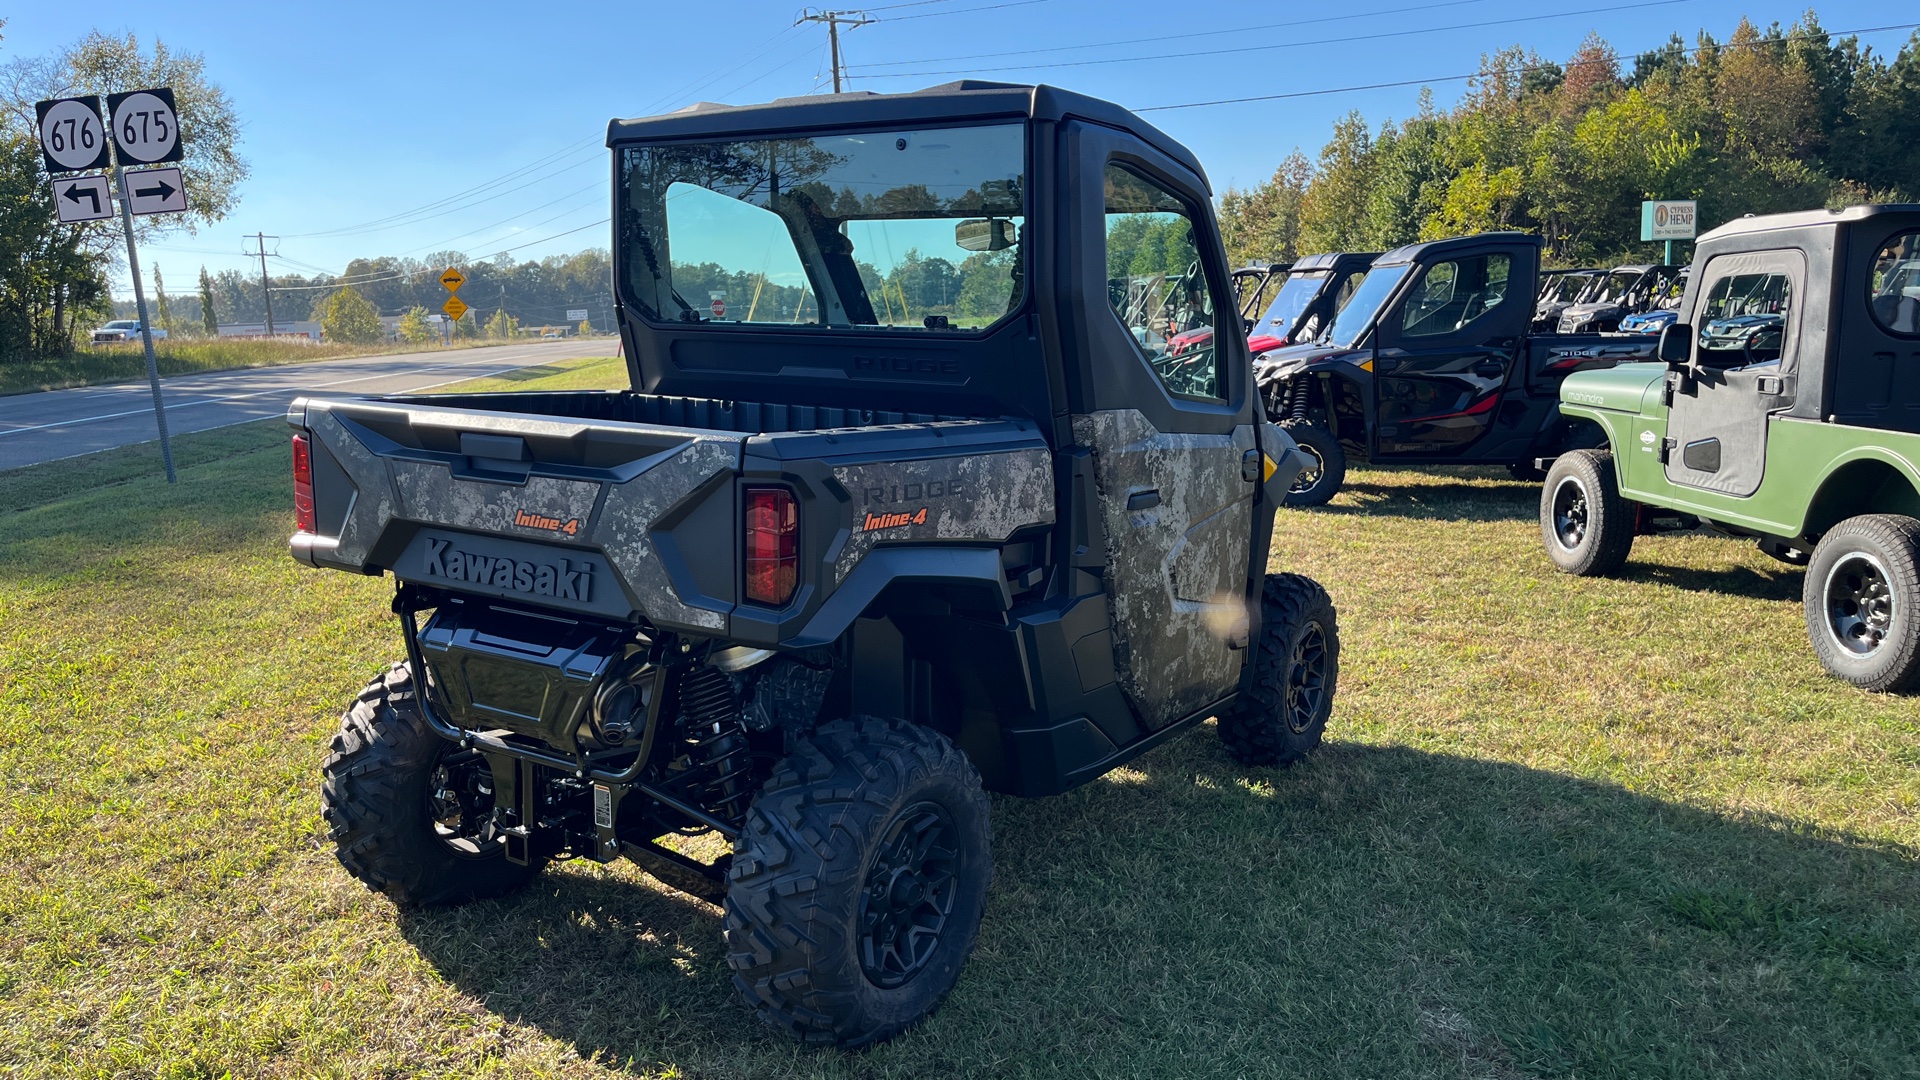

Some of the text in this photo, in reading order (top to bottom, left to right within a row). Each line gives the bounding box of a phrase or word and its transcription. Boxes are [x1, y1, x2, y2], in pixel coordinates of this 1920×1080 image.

[51, 117, 95, 152] 676
[123, 110, 168, 145] 675
[1670, 206, 1693, 214] CYPRESS
[1670, 214, 1693, 225] HEMP
[853, 355, 960, 374] RIDGE
[1567, 391, 1604, 405] mahindra
[863, 479, 963, 505] RIDGE
[514, 509, 579, 536] Inline-4
[863, 507, 928, 531] Inline-4
[423, 537, 597, 602] Kawasaki
